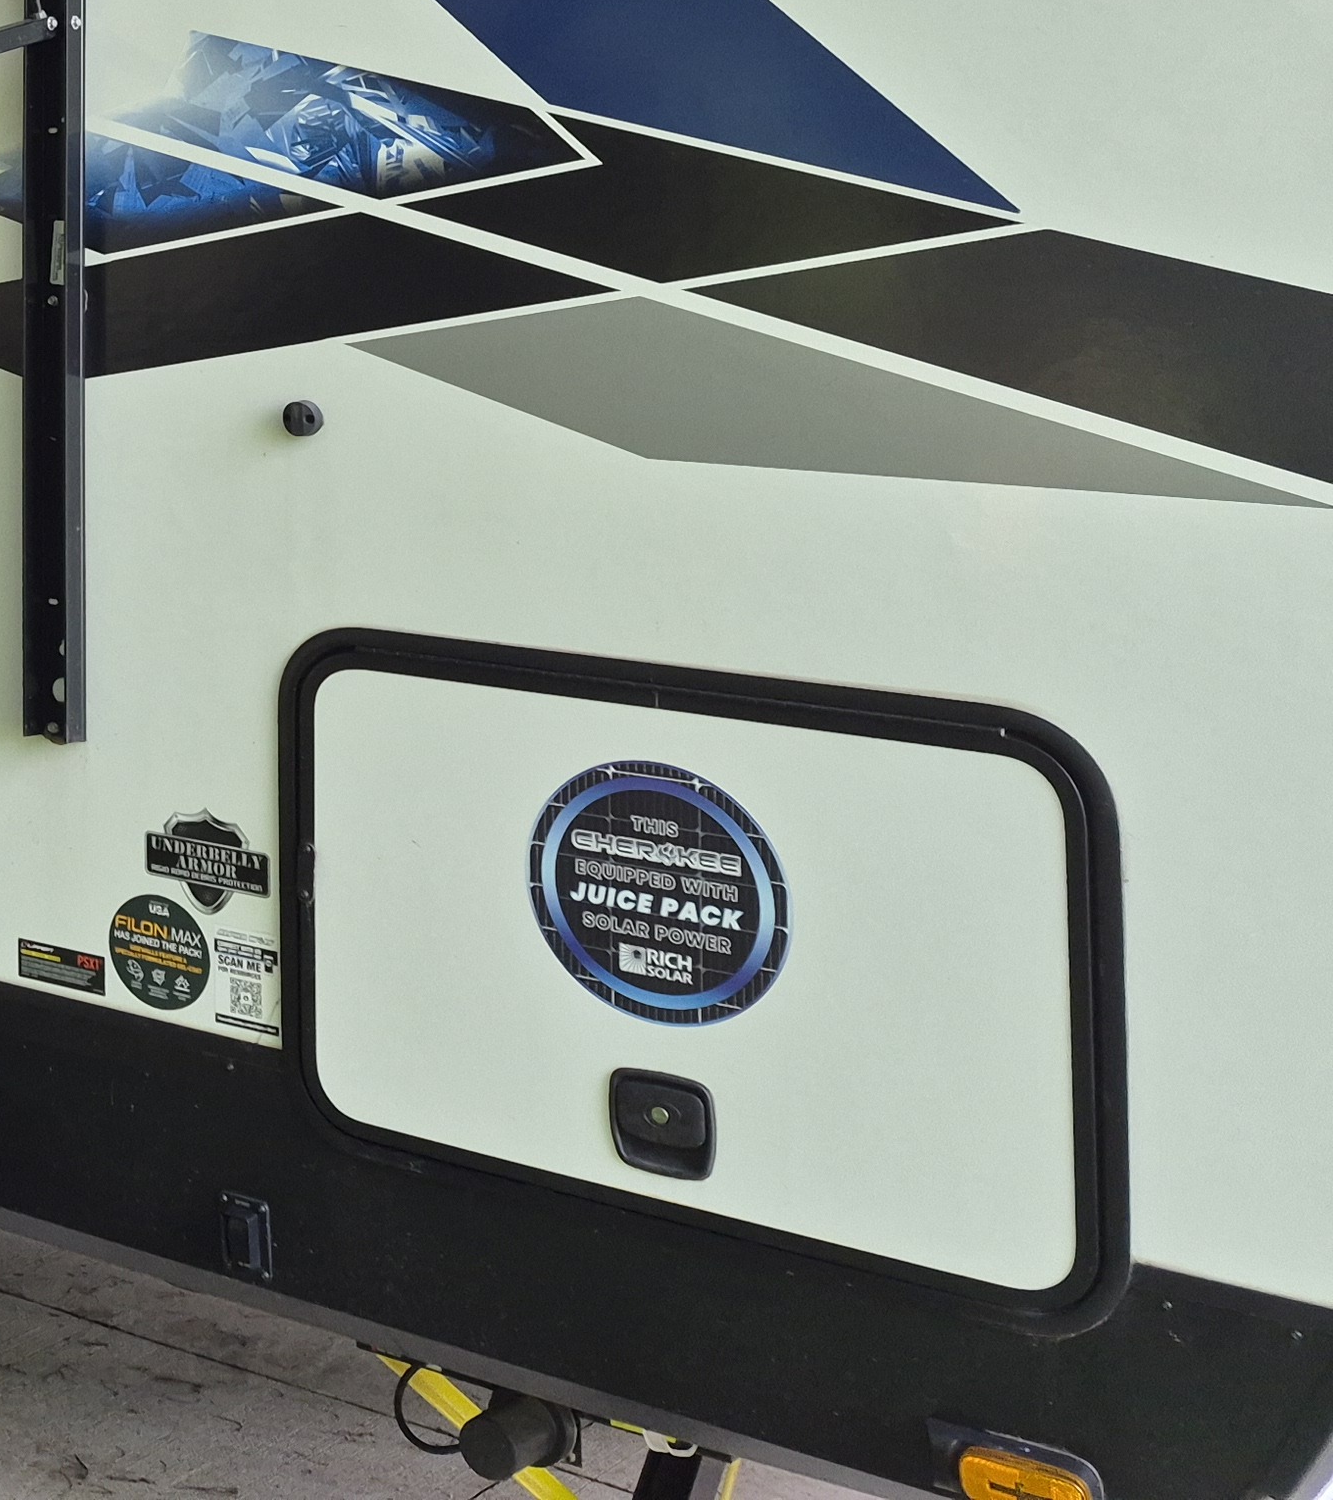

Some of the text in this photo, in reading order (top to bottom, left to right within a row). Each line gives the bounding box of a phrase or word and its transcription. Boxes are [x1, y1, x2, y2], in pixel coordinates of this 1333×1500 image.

[630, 814, 680, 838] THIS
[150, 835, 263, 870] UNDERBELLY
[176, 855, 237, 879] ARMOR
[574, 858, 739, 902] EQUIPPED WITH
[218, 877, 263, 892] PROTECTION
[569, 881, 744, 931] JUICE PACK
[114, 914, 168, 940] FILON
[171, 926, 202, 948] MAX
[114, 929, 130, 941] HAS
[131, 933, 160, 948] JOINED
[161, 940, 177, 953] THE
[178, 945, 203, 959] PACK!
[582, 911, 733, 955] SOLAR POWER
[218, 954, 262, 973] SCAN ME
[646, 948, 693, 973] RICH
[646, 963, 693, 985] SOLAR
